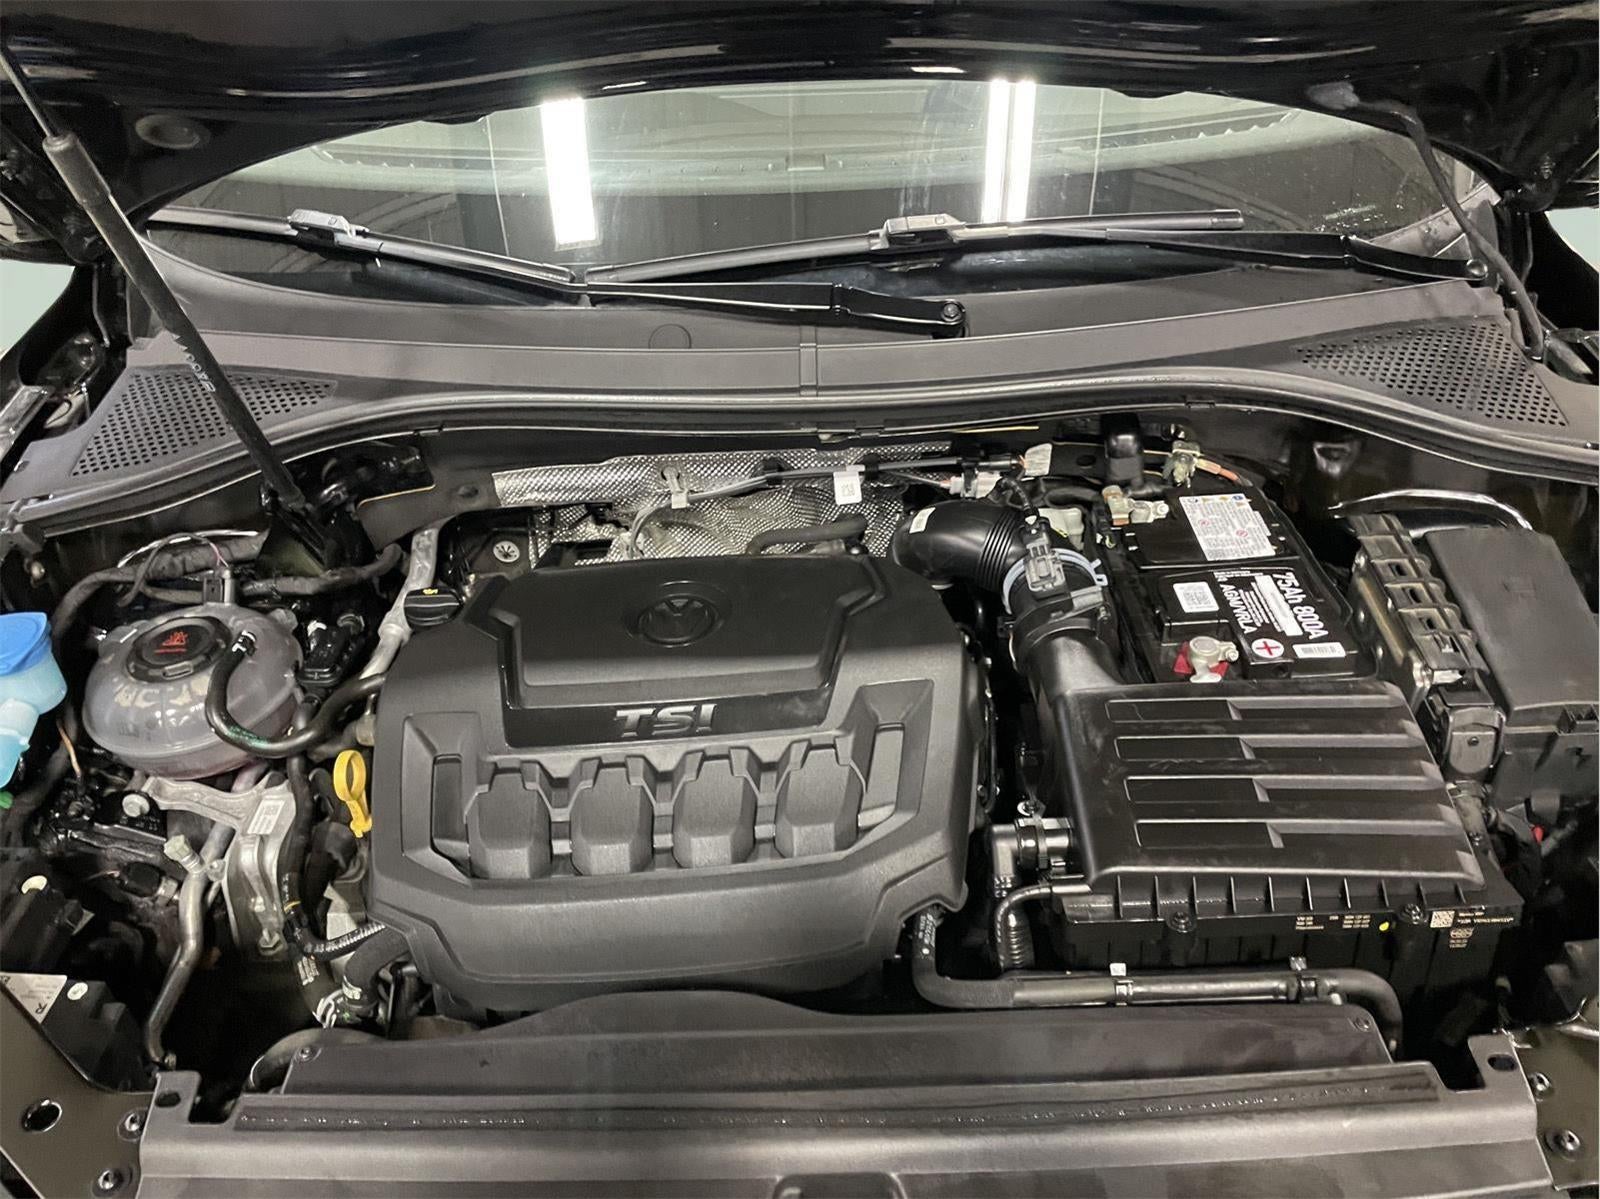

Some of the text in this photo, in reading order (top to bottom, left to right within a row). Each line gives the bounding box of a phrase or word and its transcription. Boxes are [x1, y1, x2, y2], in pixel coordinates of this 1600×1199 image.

[1272, 572, 1306, 604] 75Ah
[1293, 605, 1329, 640] 800A
[614, 703, 718, 738] TSI
